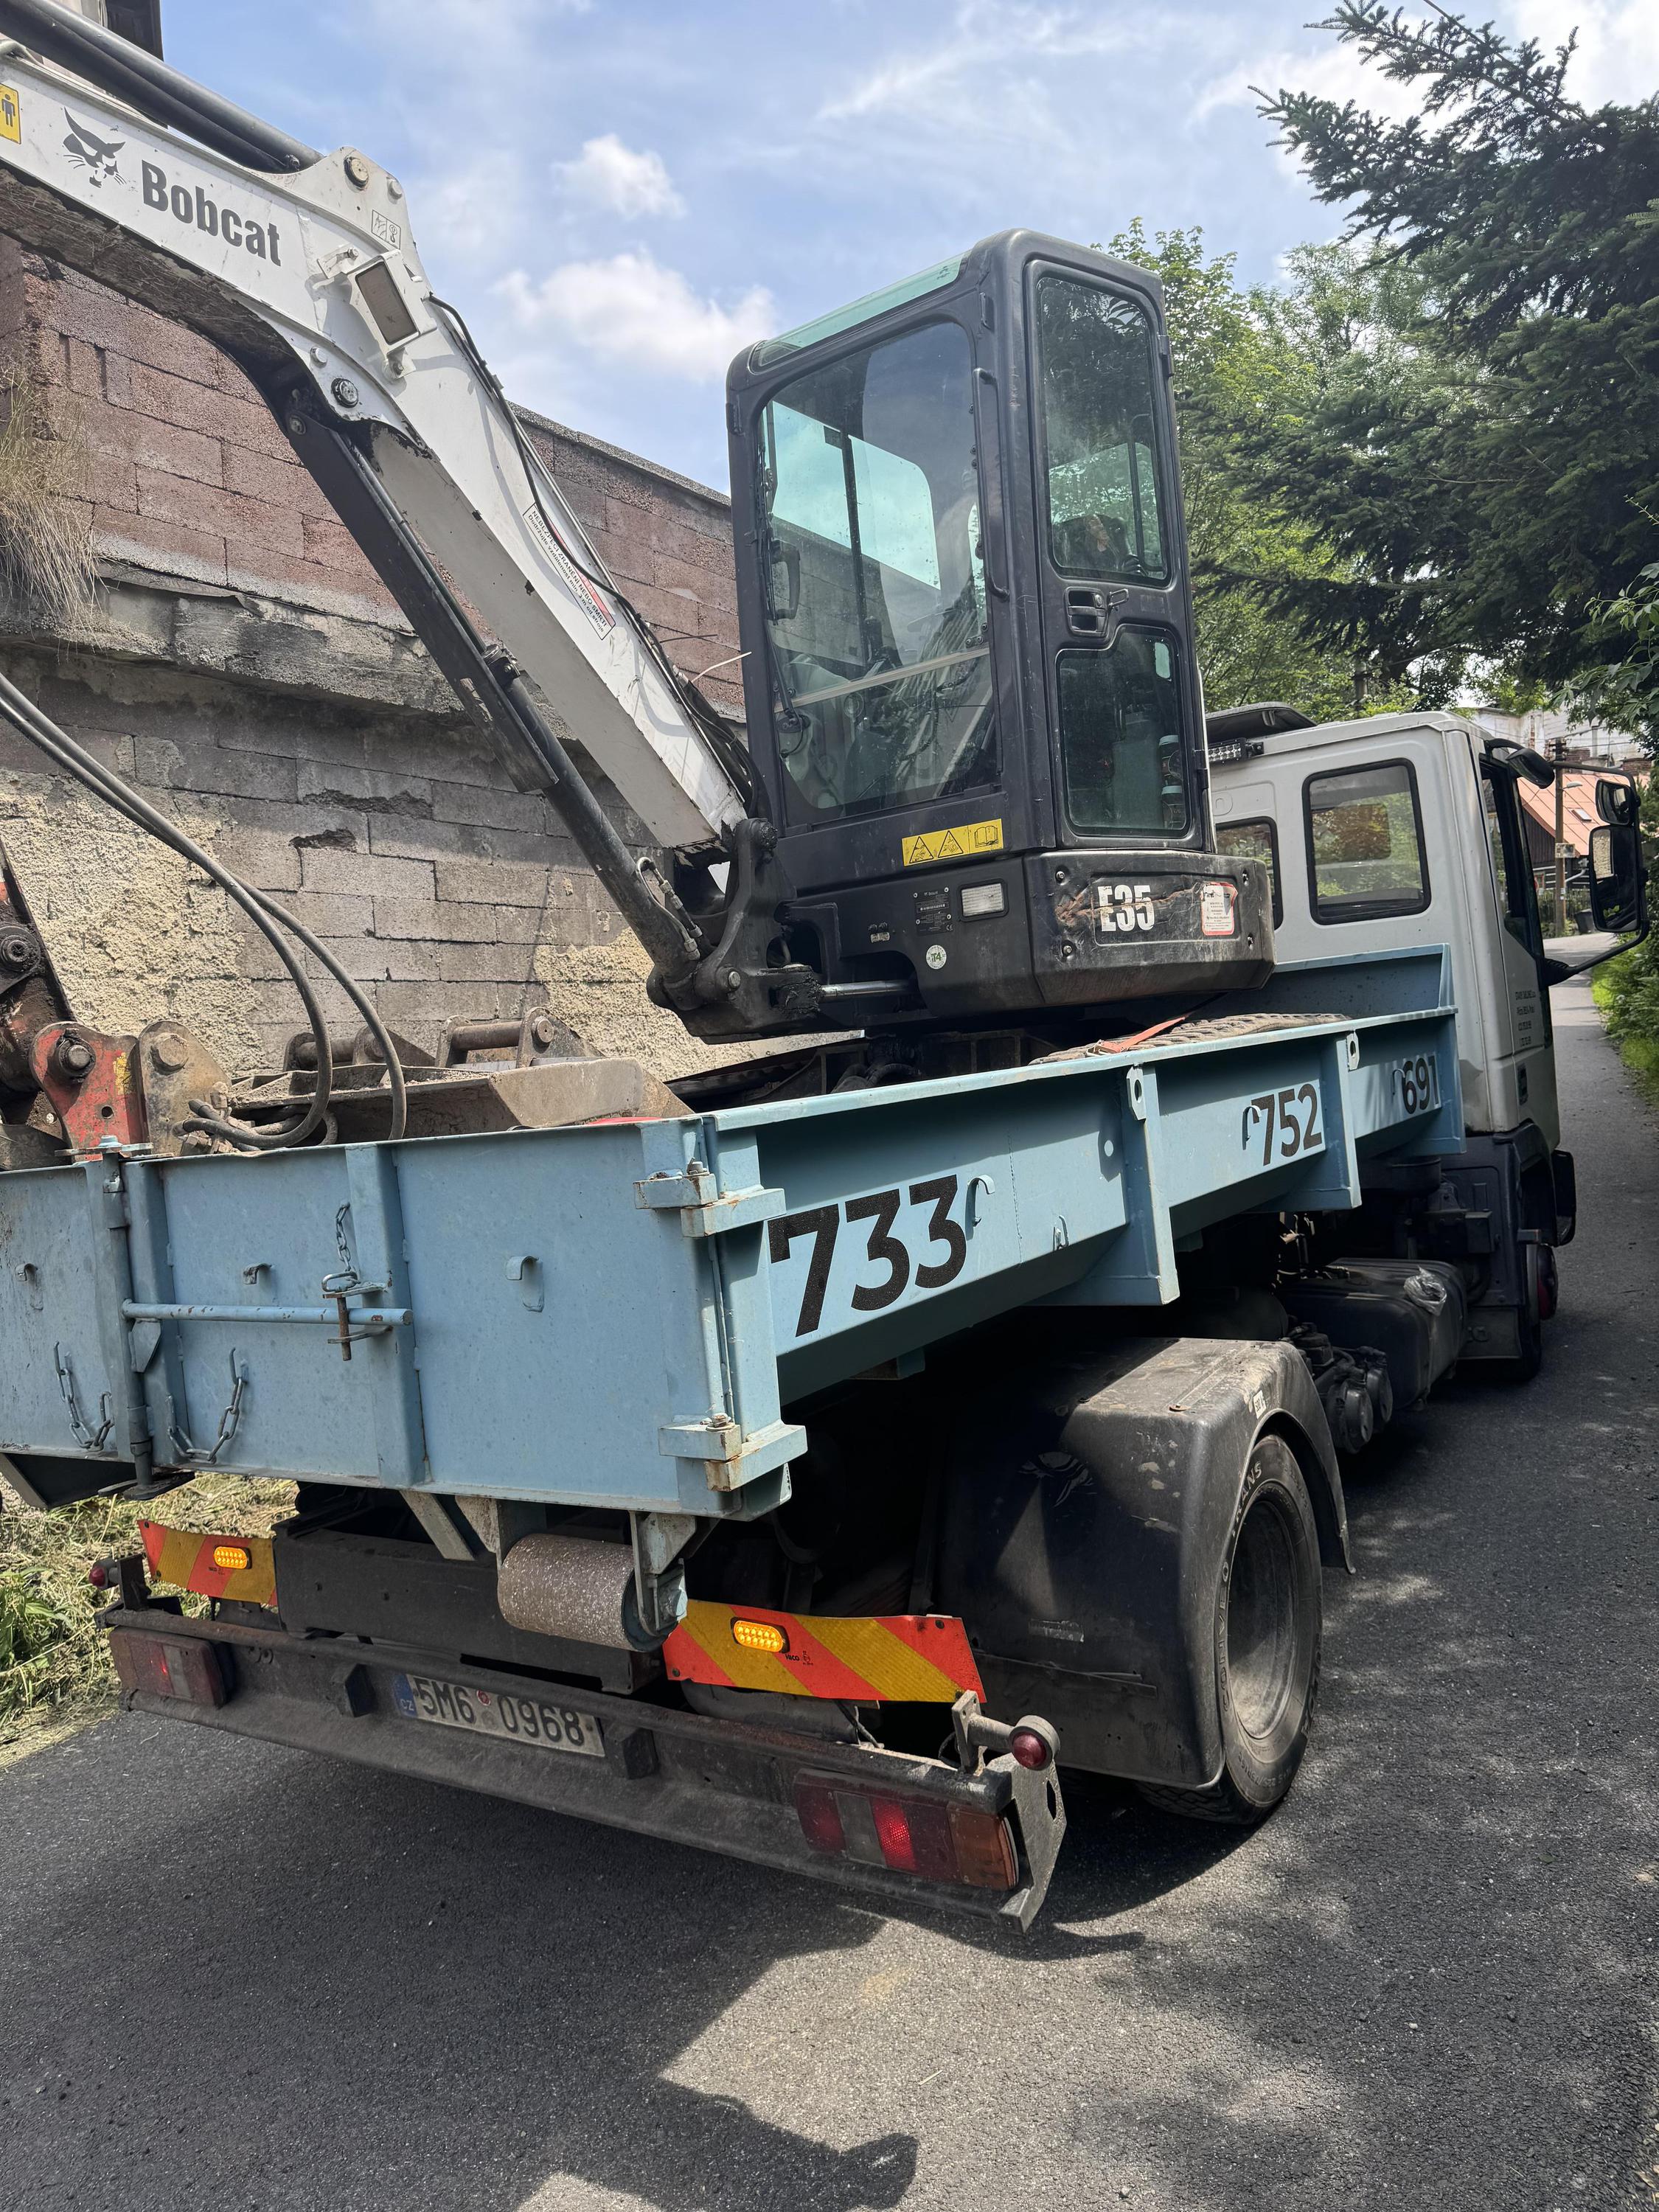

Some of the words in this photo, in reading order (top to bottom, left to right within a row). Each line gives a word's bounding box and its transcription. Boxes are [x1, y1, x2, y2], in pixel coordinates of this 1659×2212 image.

[142, 159, 282, 267] Bobcat
[577, 582, 593, 605] NEBO
[591, 603, 608, 627] SMRTI
[1098, 885, 1155, 932] E35
[1402, 1056, 1439, 1114] 691
[1251, 1084, 1322, 1166] 752
[768, 1174, 967, 1338] 733
[400, 1698, 414, 1711] CZ
[413, 1677, 476, 1724] 5M6
[496, 1695, 585, 1747] 0968
